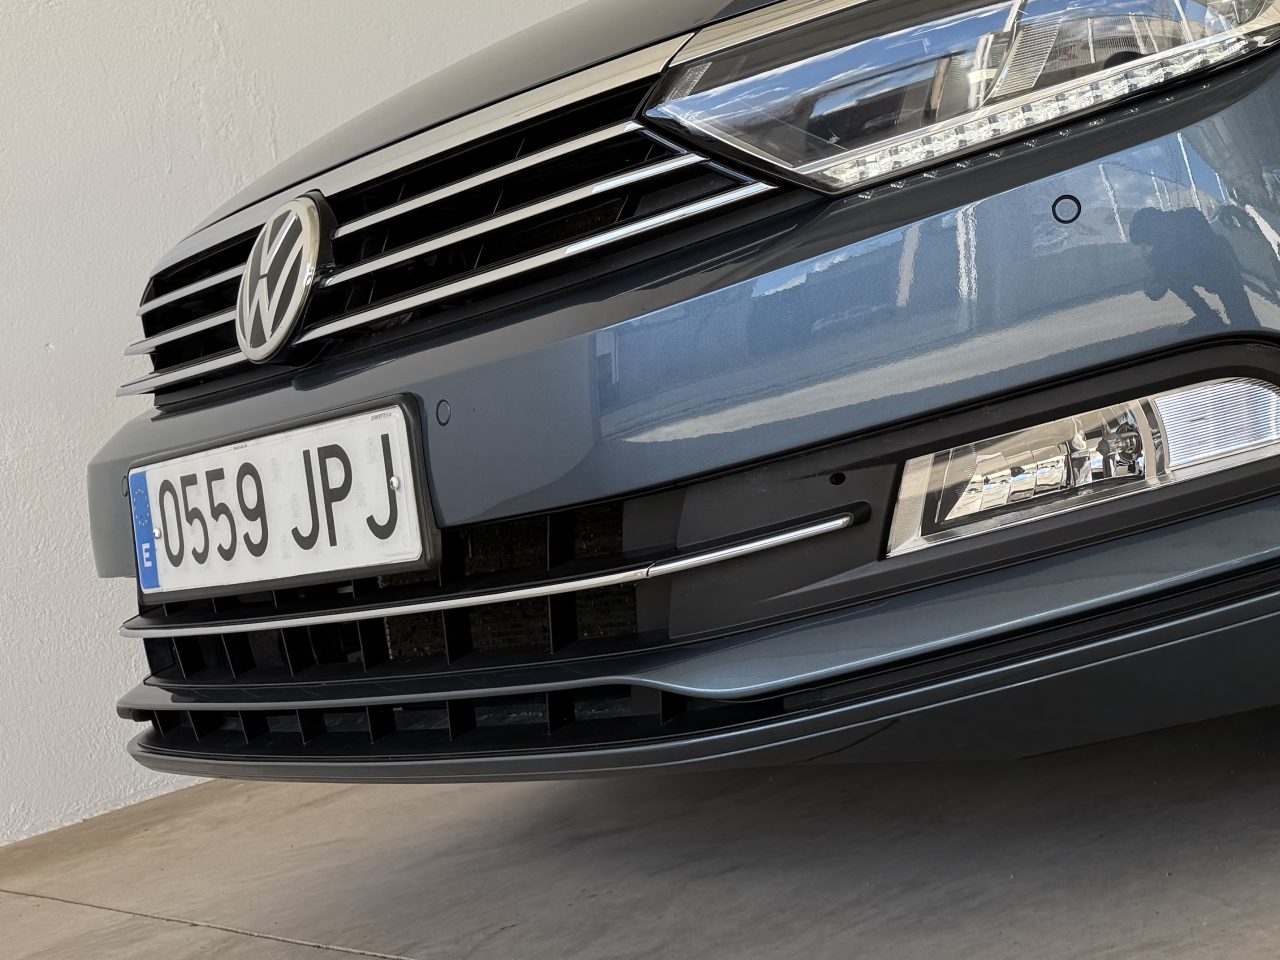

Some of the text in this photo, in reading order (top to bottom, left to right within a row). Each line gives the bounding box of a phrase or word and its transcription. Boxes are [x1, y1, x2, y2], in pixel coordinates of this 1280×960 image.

[158, 433, 398, 567] 0559 JPJ
[141, 542, 153, 568] E
